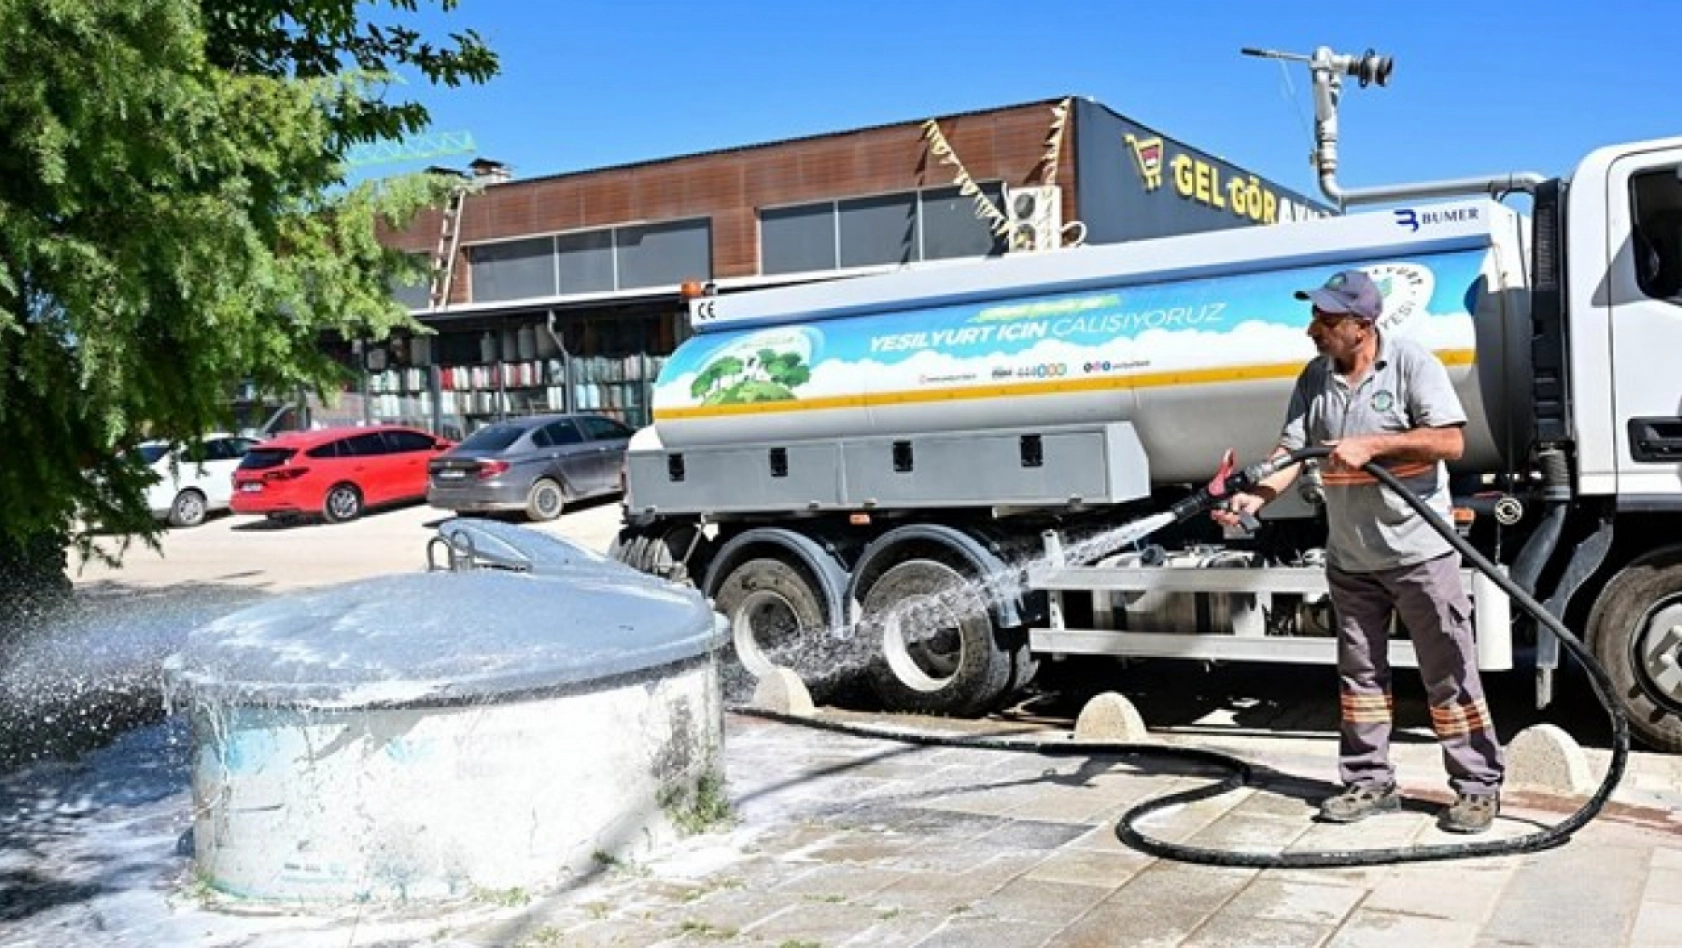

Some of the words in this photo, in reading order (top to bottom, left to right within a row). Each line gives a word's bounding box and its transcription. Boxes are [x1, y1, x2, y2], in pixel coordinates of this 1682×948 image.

[1172, 153, 1225, 208] GEL
[1227, 174, 1277, 225] GÖR
[1421, 207, 1480, 225] BUMER
